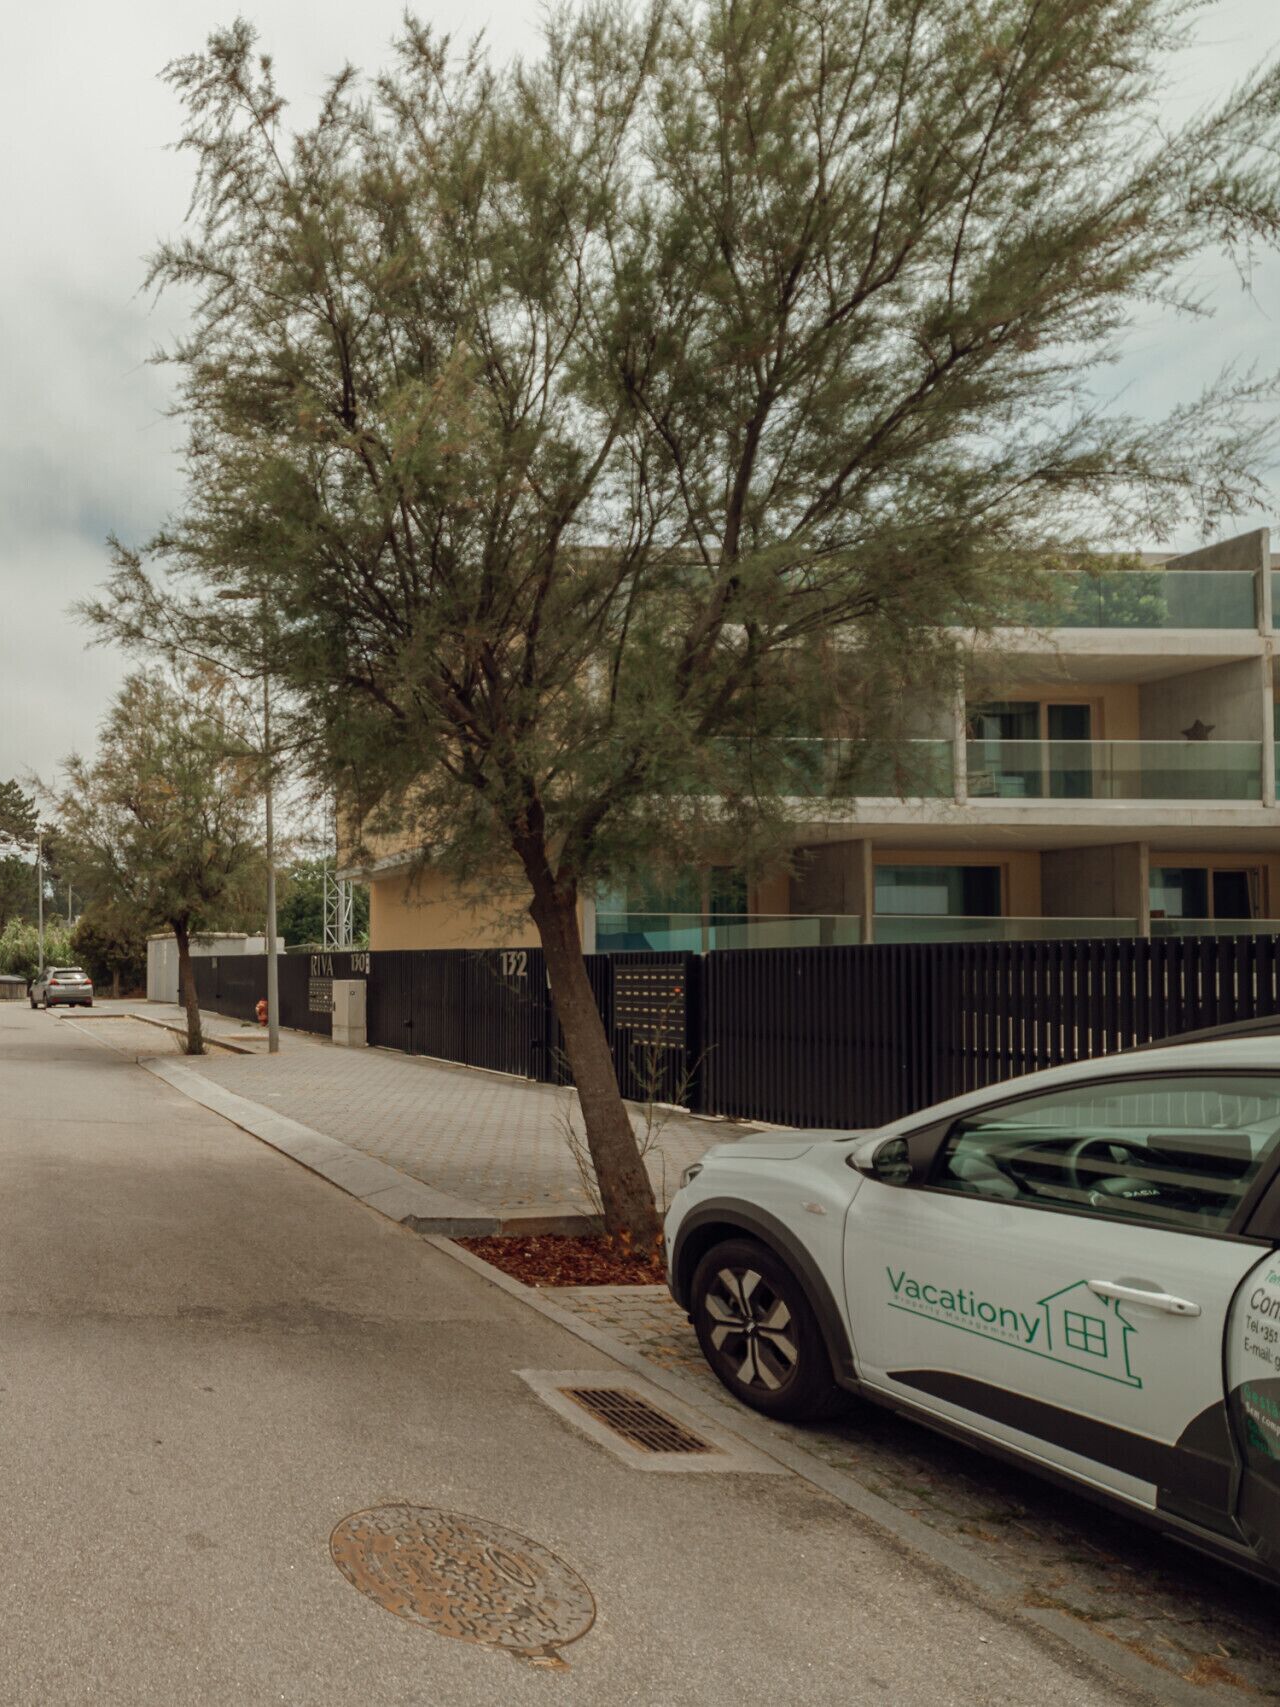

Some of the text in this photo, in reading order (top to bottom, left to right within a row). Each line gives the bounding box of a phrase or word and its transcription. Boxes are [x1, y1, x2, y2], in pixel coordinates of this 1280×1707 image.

[311, 954, 334, 976] RIVA
[351, 953, 365, 971] 130
[500, 951, 527, 976] 132
[886, 1266, 1040, 1343] Vacationy
